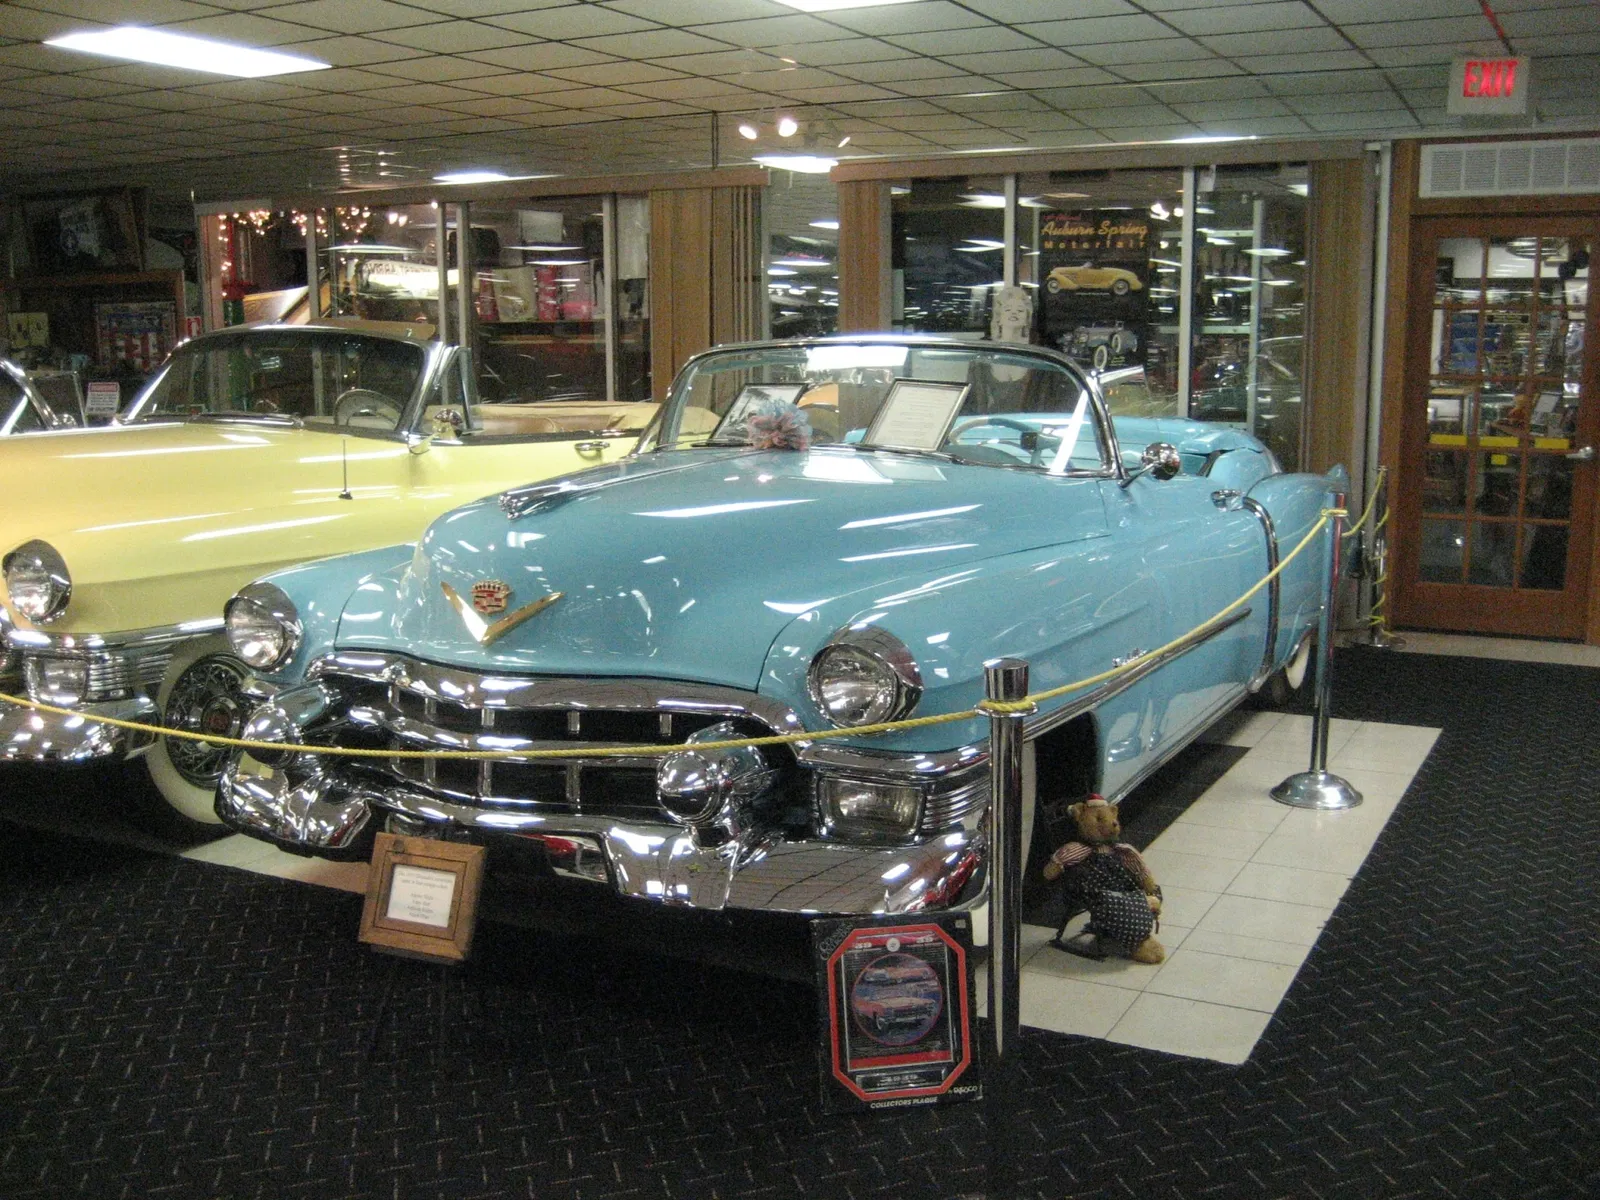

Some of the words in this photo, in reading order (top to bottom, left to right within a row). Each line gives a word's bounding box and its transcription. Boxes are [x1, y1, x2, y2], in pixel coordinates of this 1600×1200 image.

[1463, 60, 1518, 97] EXIT
[1041, 221, 1095, 236] Auburn
[1098, 220, 1148, 241] Spring
[870, 1099, 911, 1109] COLLECTORS
[913, 1096, 938, 1106] PLAQUE
